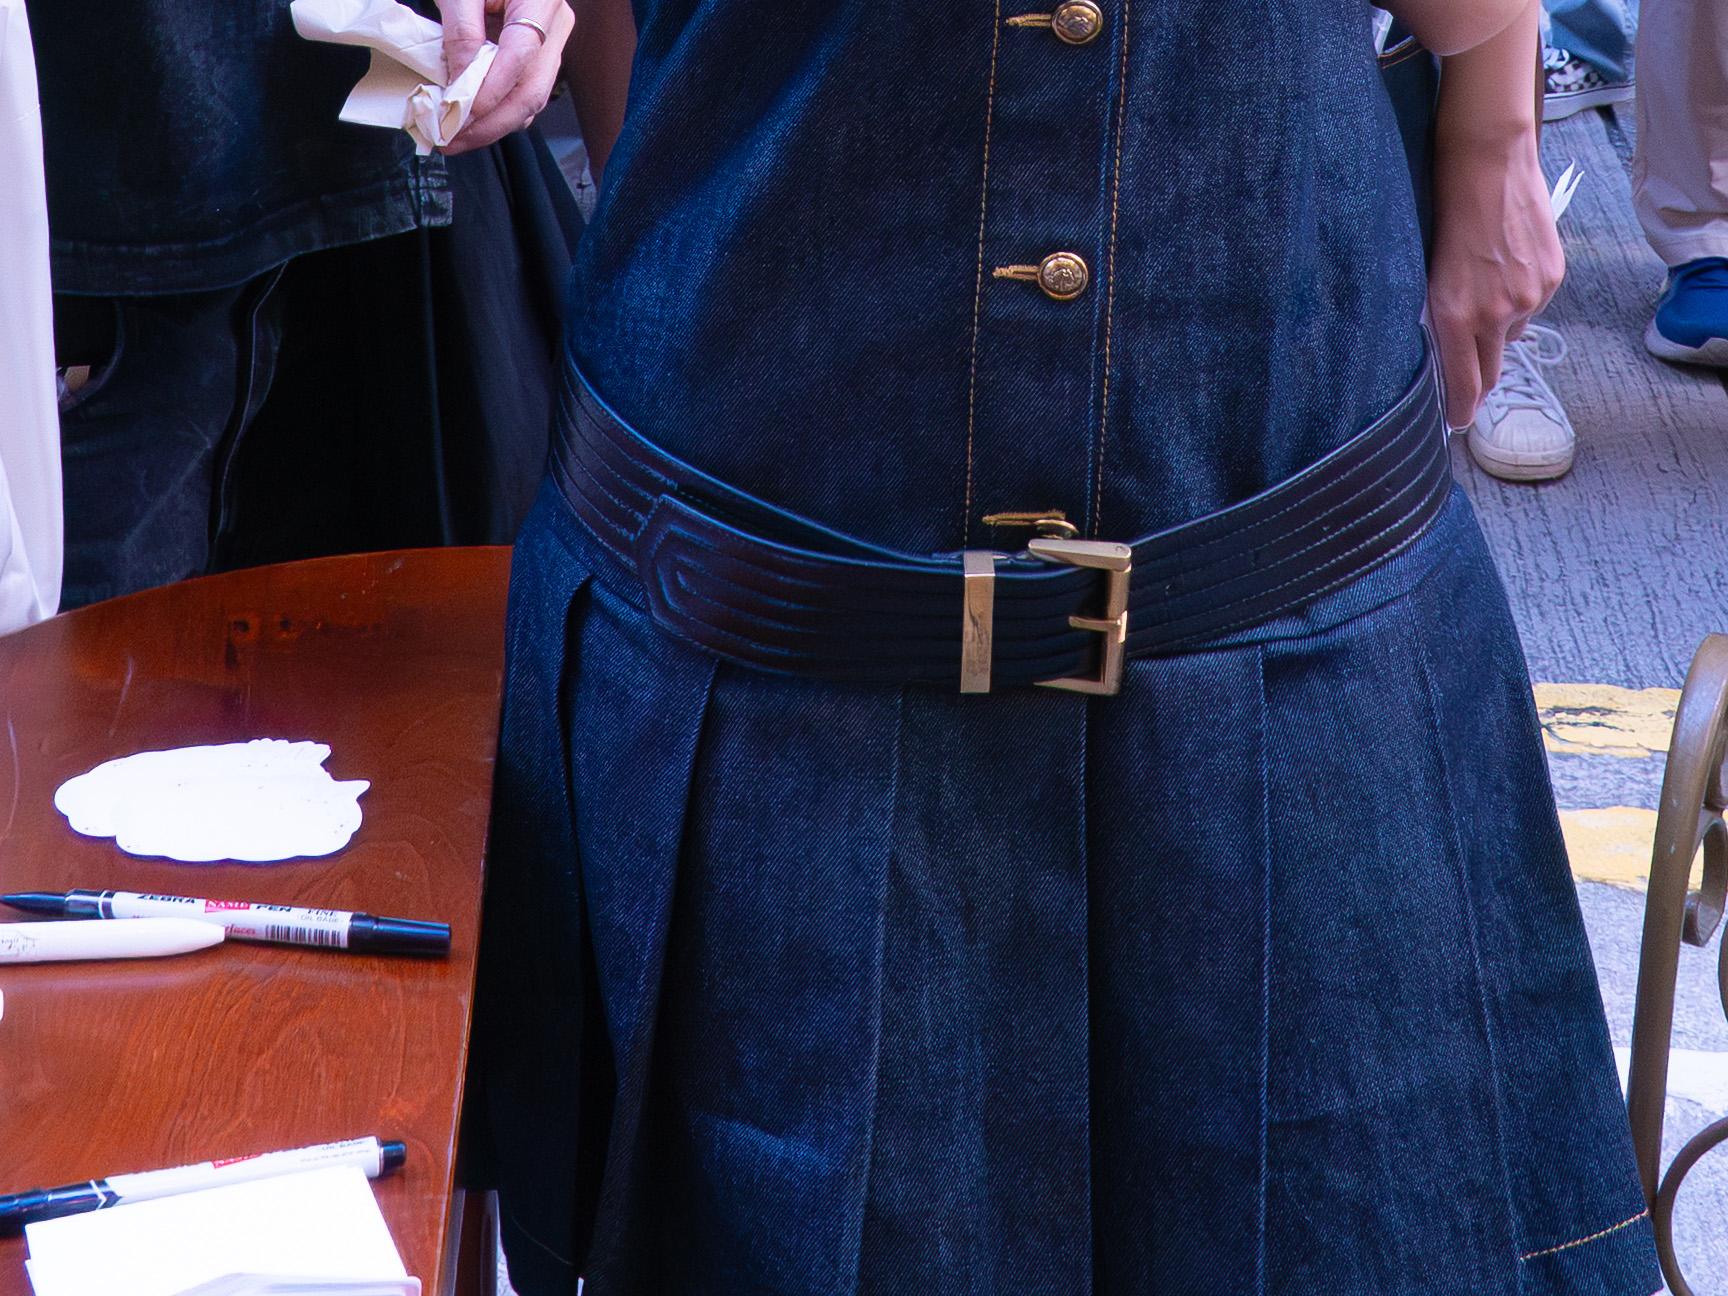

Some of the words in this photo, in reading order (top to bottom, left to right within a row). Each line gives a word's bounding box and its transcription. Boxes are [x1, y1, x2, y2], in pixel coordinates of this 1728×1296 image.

[137, 894, 196, 904] ZEBRA
[207, 899, 249, 910] NAME
[256, 904, 293, 913] PEN
[225, 923, 256, 936] rfaces
